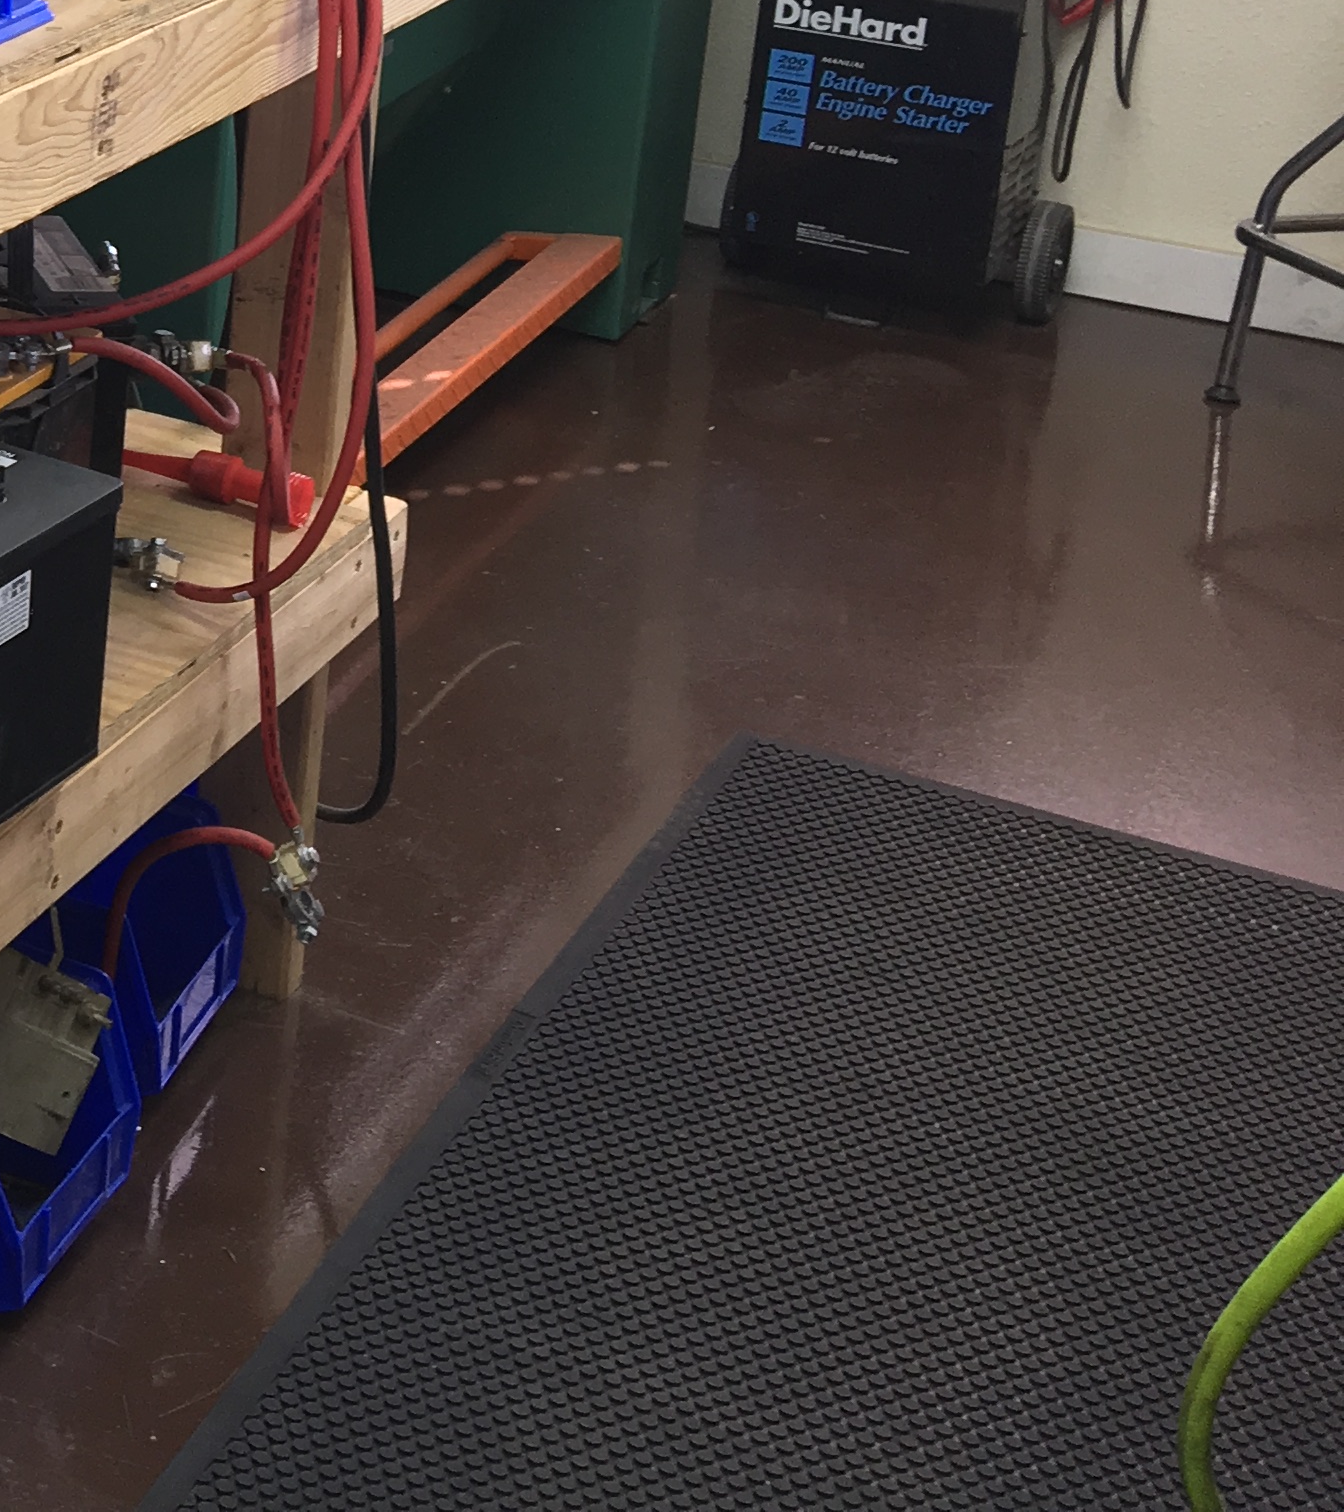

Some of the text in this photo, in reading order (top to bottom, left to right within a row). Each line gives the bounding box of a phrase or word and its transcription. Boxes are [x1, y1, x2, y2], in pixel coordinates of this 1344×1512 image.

[776, 54, 809, 67] 200
[820, 56, 866, 69] MANUAL
[777, 88, 799, 97] 40
[819, 70, 994, 118] Battery Charger
[815, 92, 970, 135] Engine Starter
[779, 119, 789, 129] 2
[808, 141, 900, 166] For 12 volt batteries
